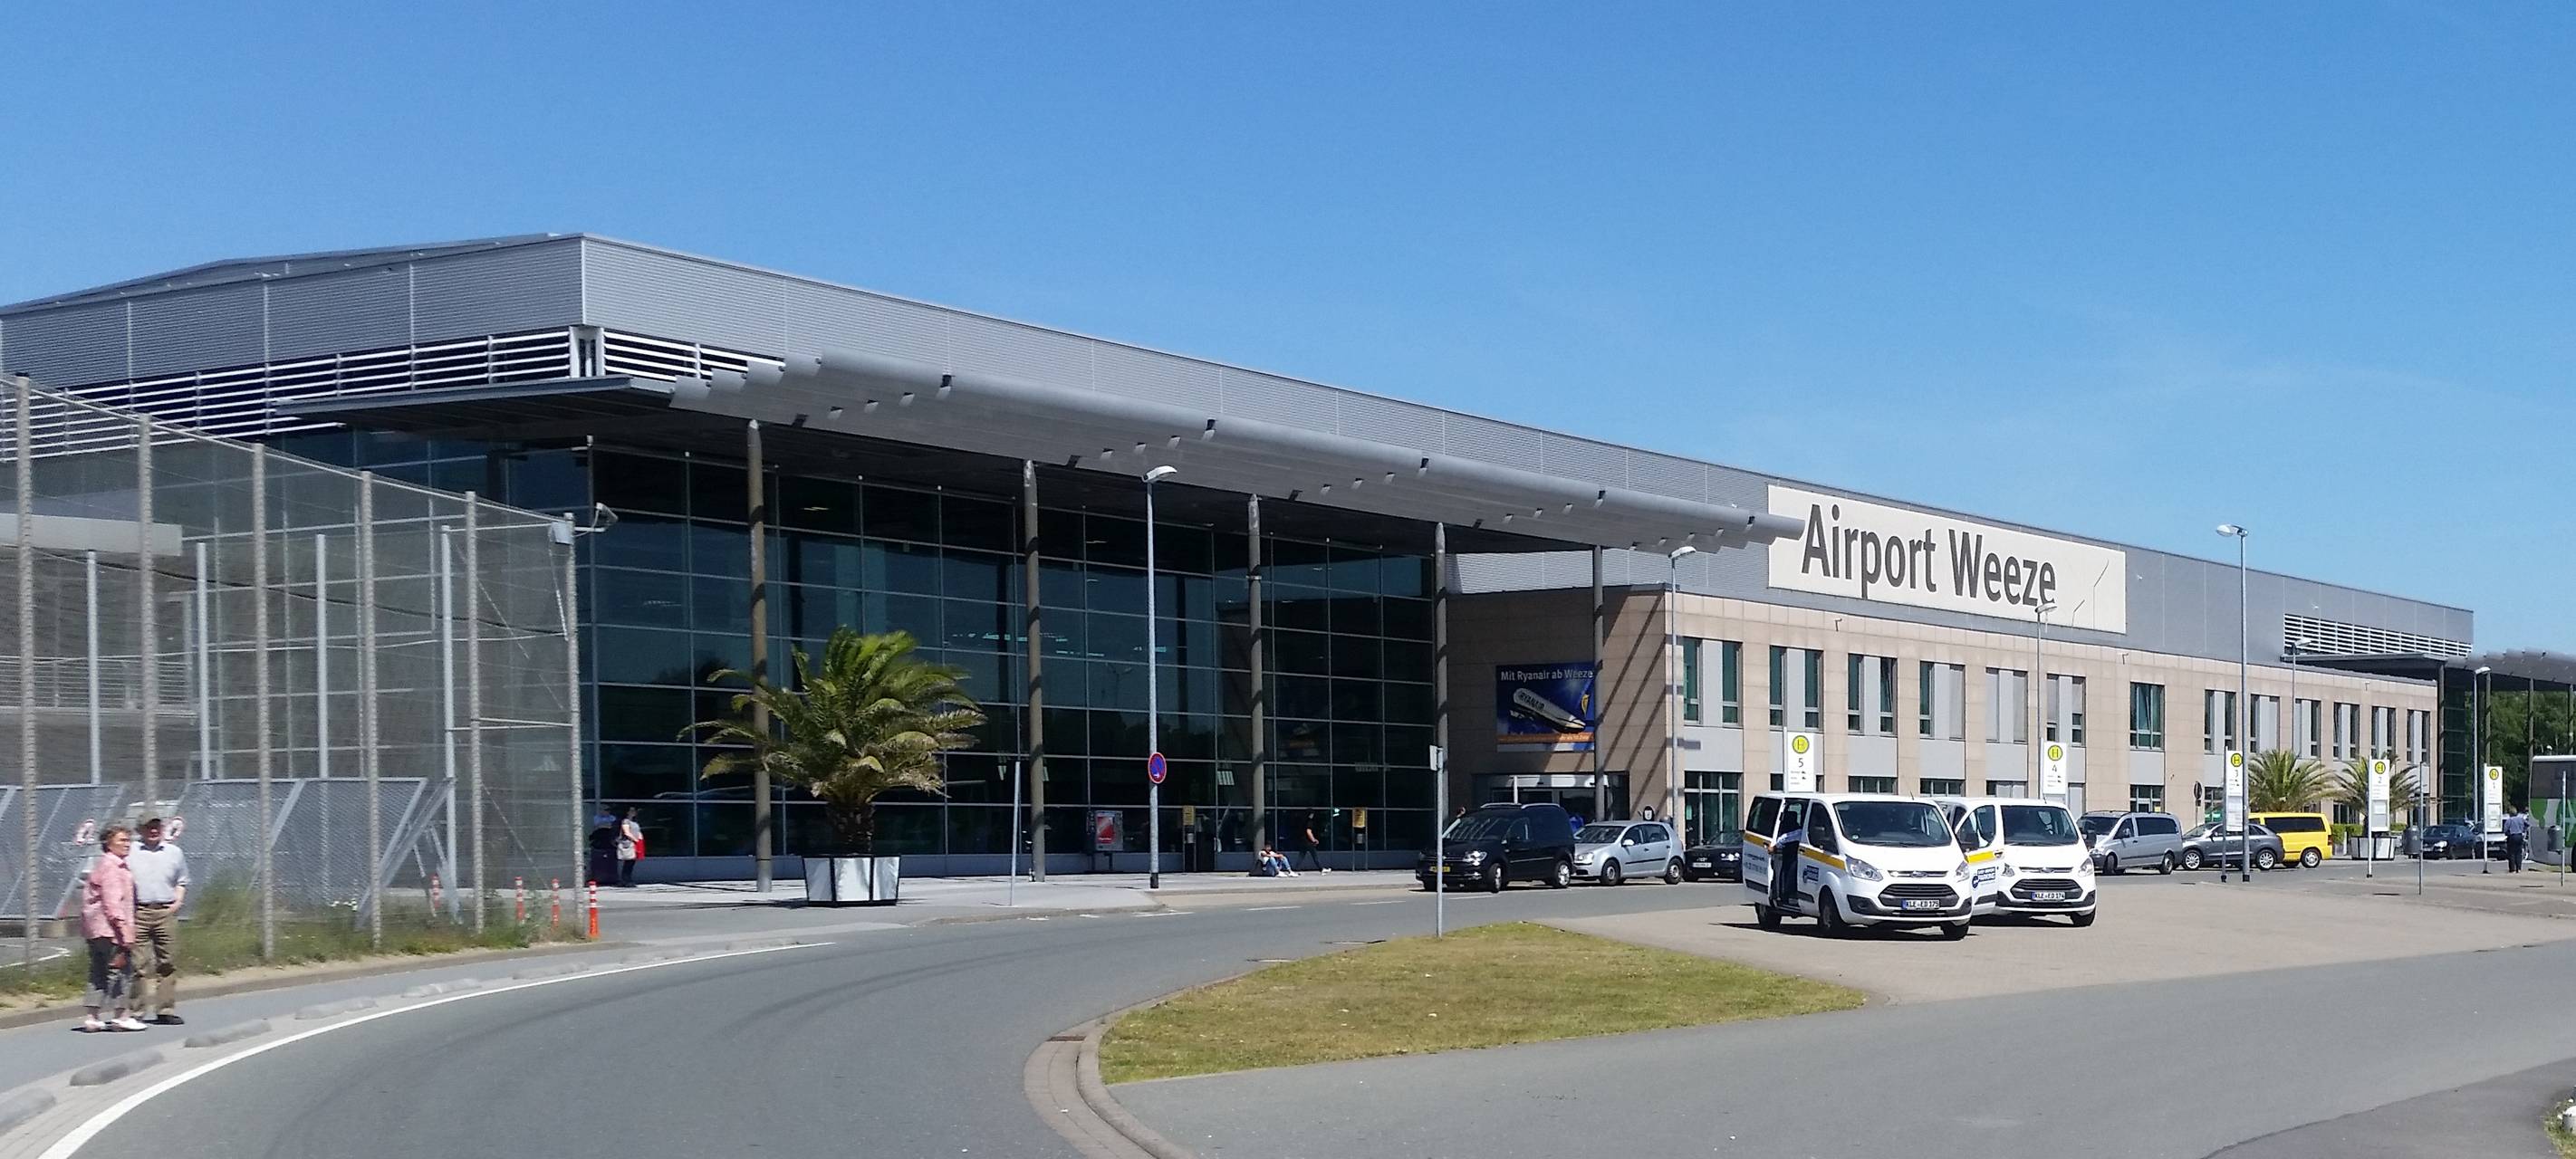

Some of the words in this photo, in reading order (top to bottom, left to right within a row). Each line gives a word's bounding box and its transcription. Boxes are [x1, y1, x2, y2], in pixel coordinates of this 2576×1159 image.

[1801, 503, 1937, 599] Airport
[1948, 529, 2056, 608] Weeze
[1501, 671, 1515, 681] Mit
[1517, 670, 1550, 683] Ryanair
[1552, 669, 1562, 679] ab
[1564, 669, 1594, 679] Weeze
[1798, 757, 1804, 768] 5
